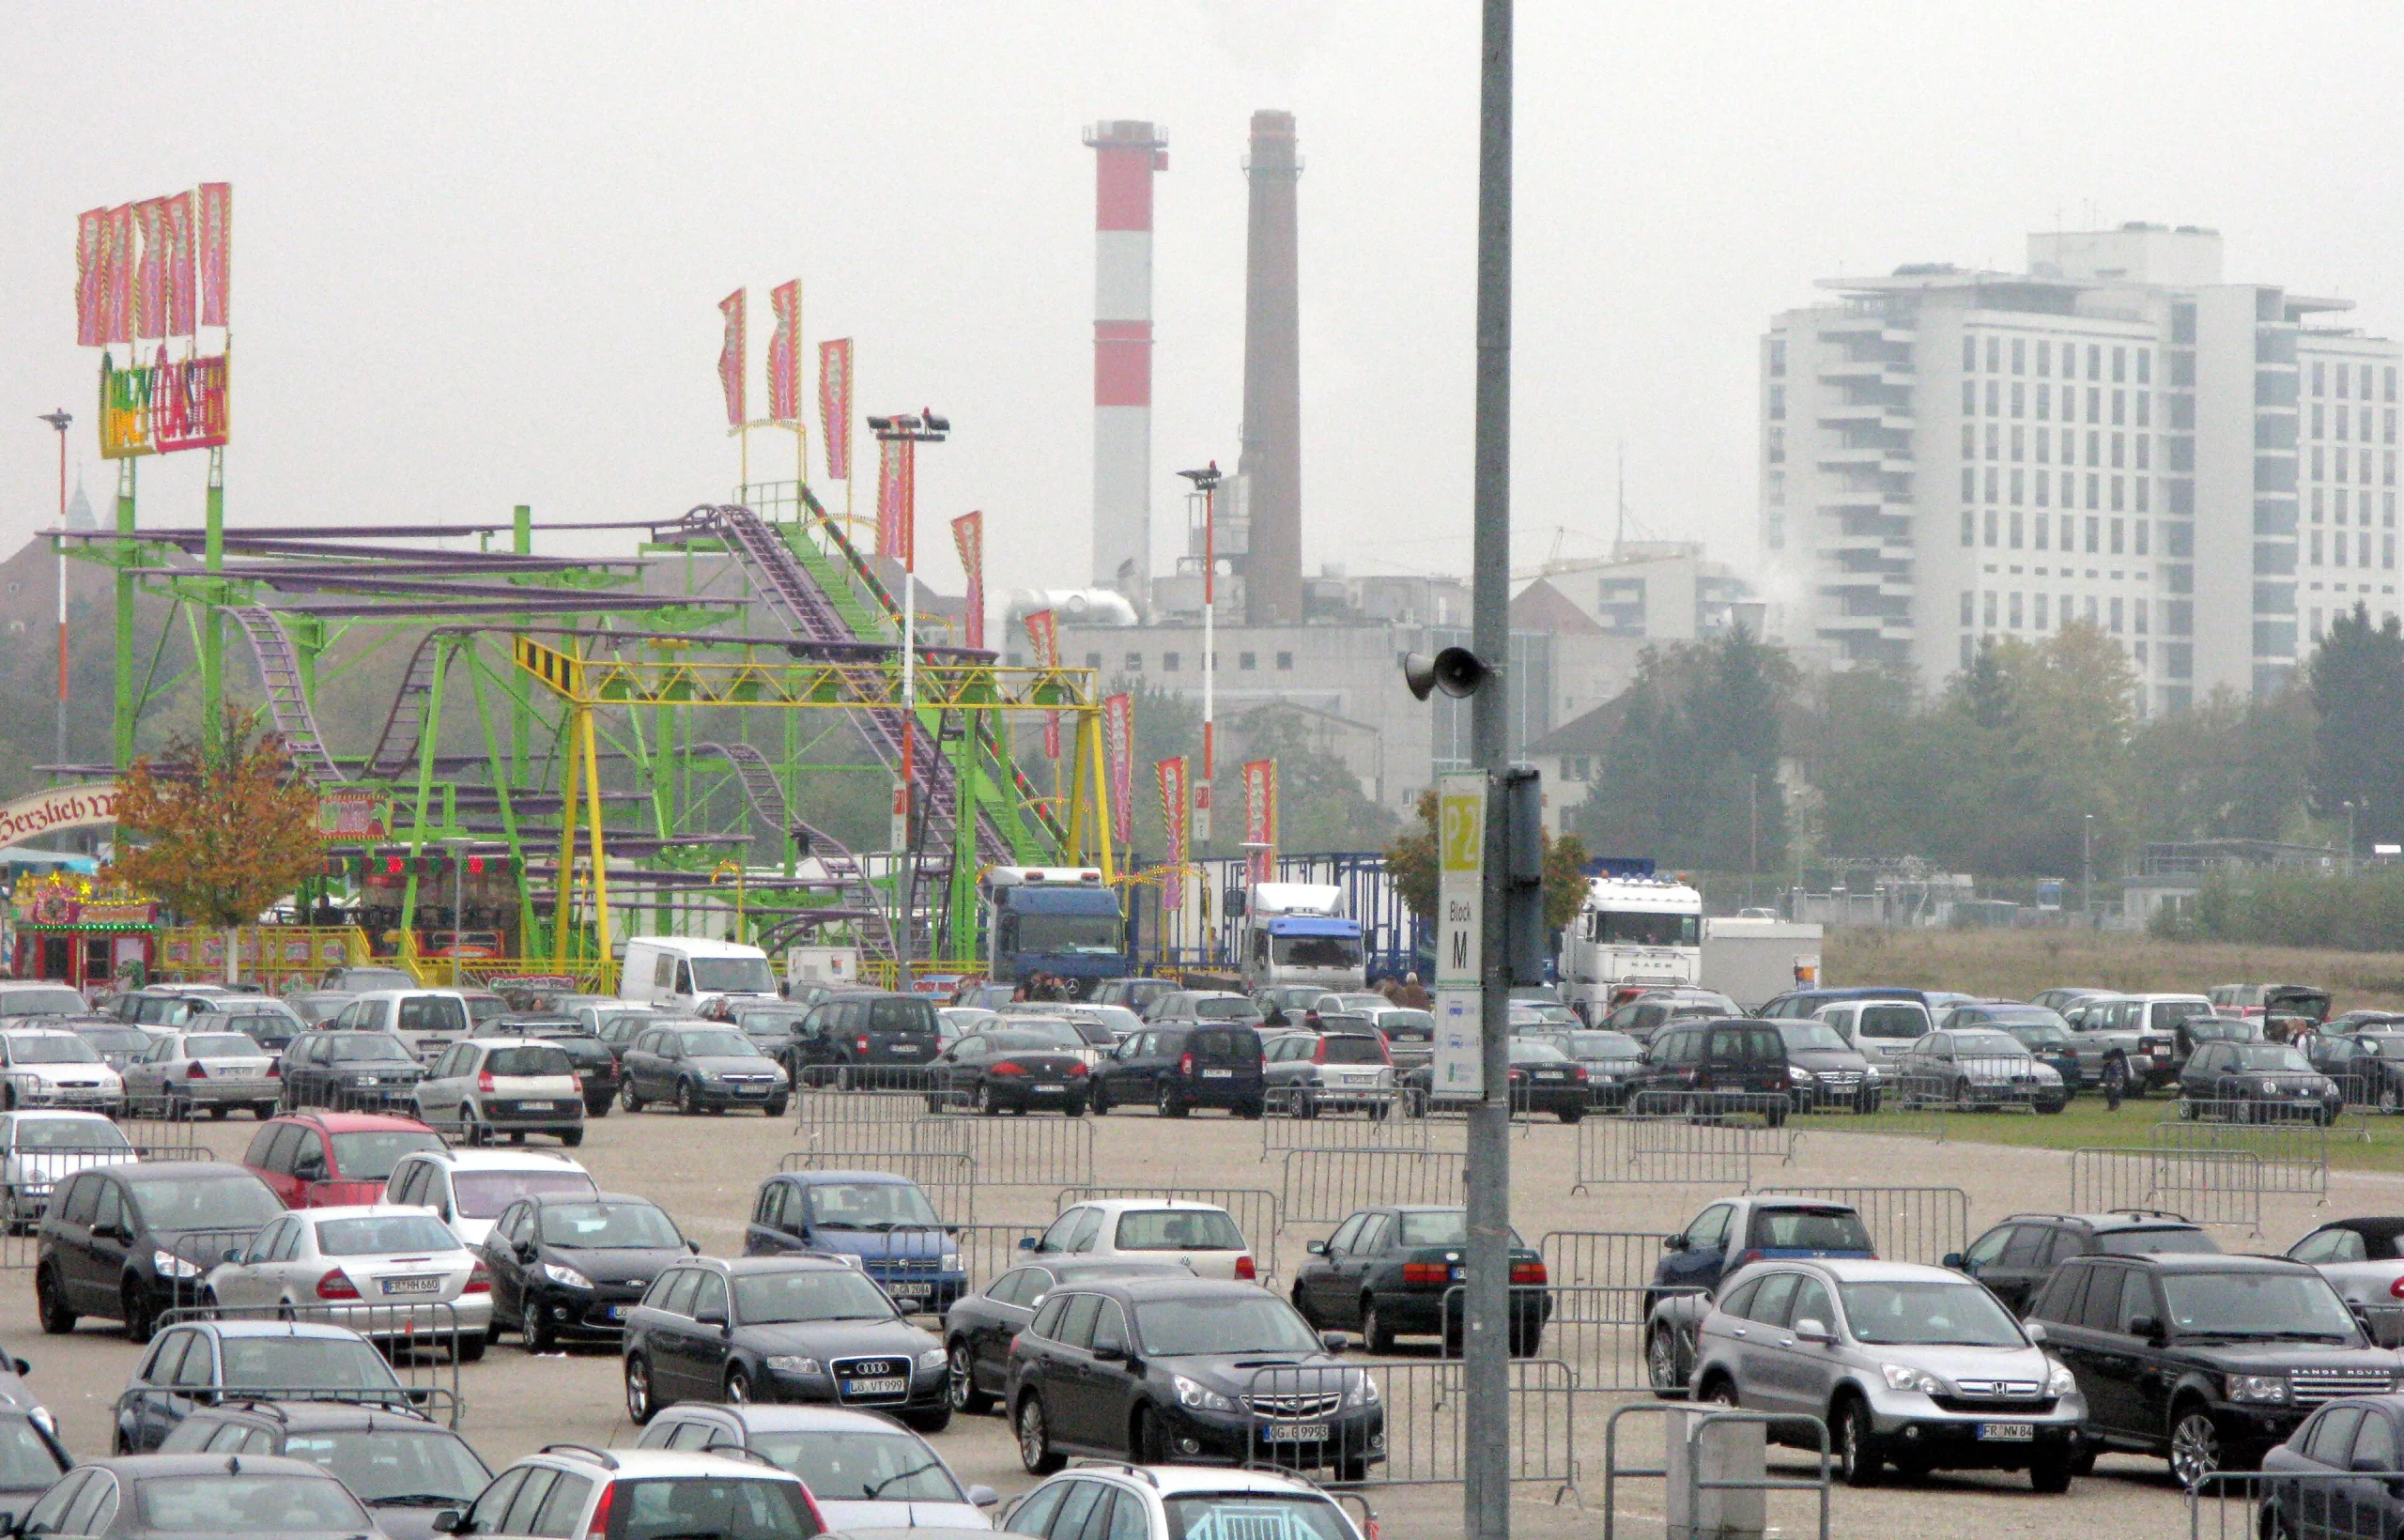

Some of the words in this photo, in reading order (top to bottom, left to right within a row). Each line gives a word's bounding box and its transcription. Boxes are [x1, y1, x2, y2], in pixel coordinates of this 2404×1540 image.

[1447, 805, 1477, 861] P2
[1449, 901, 1472, 921] Block
[1453, 931, 1467, 969] M
[1983, 1425, 1997, 1436] FR
[2004, 1425, 2018, 1437] NW
